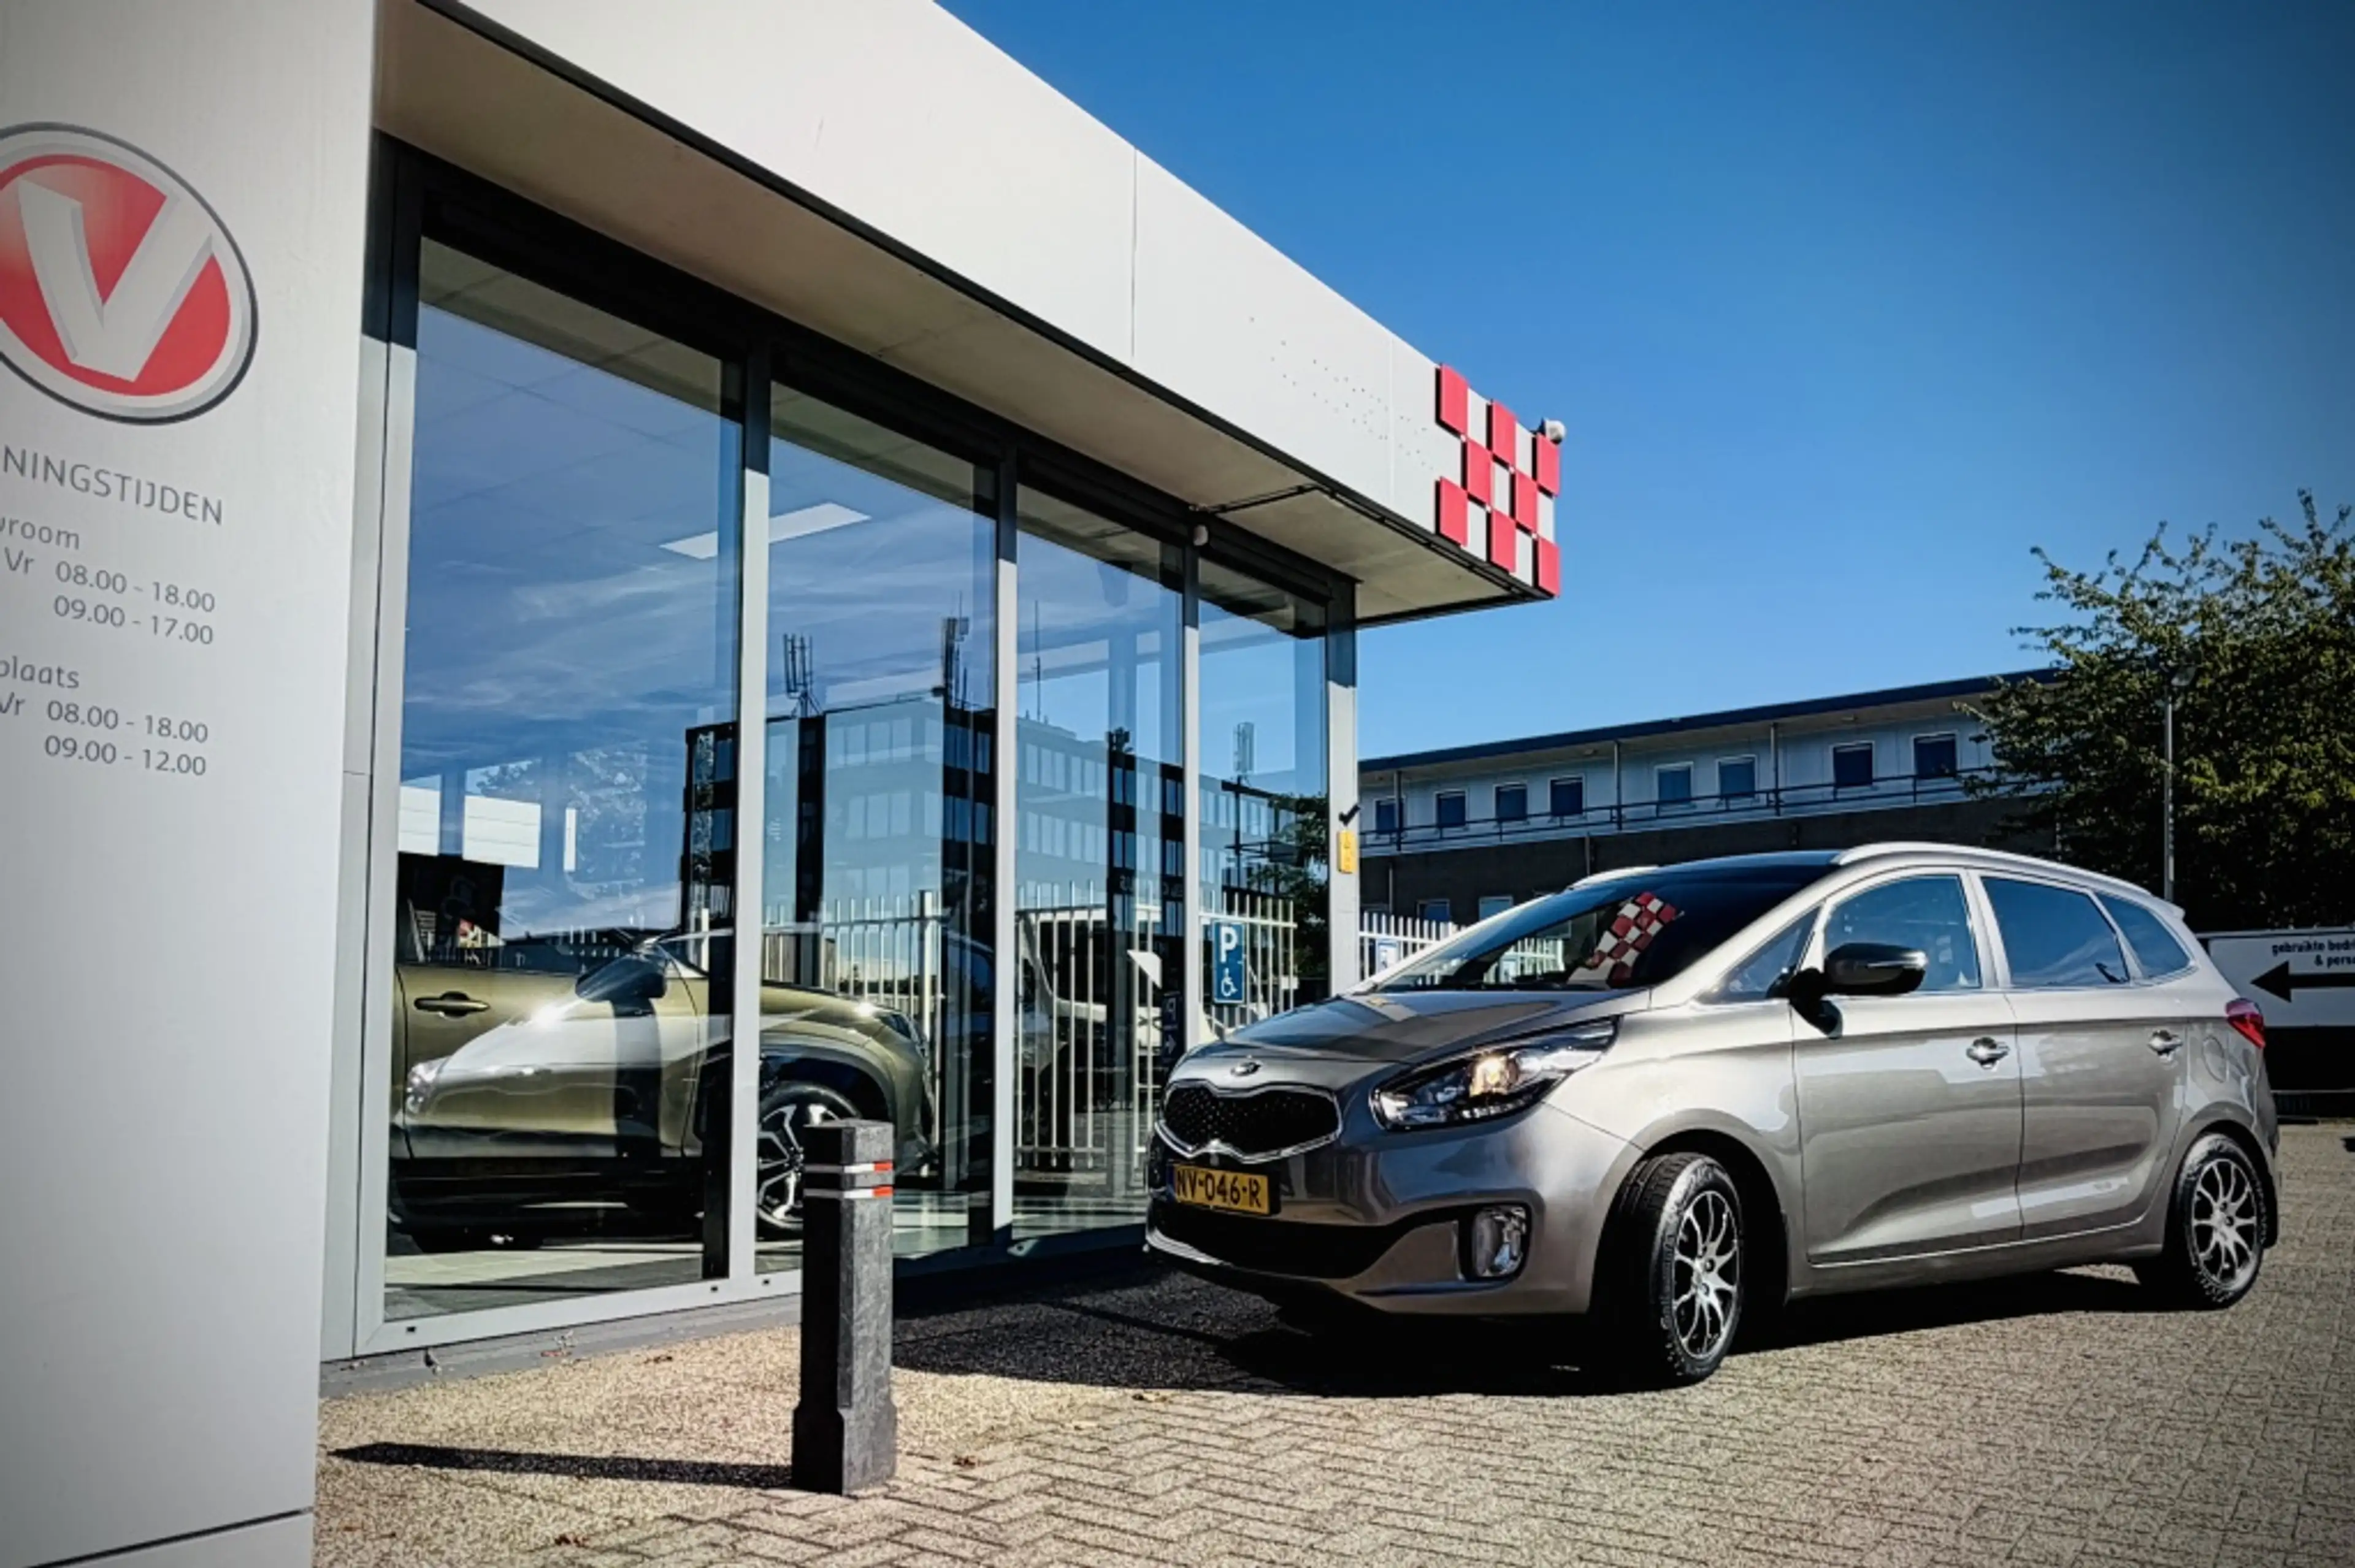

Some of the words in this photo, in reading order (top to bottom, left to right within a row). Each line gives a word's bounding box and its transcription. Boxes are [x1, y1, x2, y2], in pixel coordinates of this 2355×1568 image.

[2, 444, 223, 526] NINGSTIJDEN
[4, 546, 35, 575] Vr
[55, 560, 128, 595] 08.00
[152, 581, 216, 613] 18.00
[53, 594, 126, 628] 09.00
[151, 614, 214, 645] 17.00
[46, 700, 120, 730] 08.00
[145, 714, 209, 744] 18.00
[44, 734, 117, 765] 09.00
[142, 748, 207, 776] 12.00
[1220, 926, 1238, 963] P
[1176, 1169, 1262, 1208] NV-046-R
